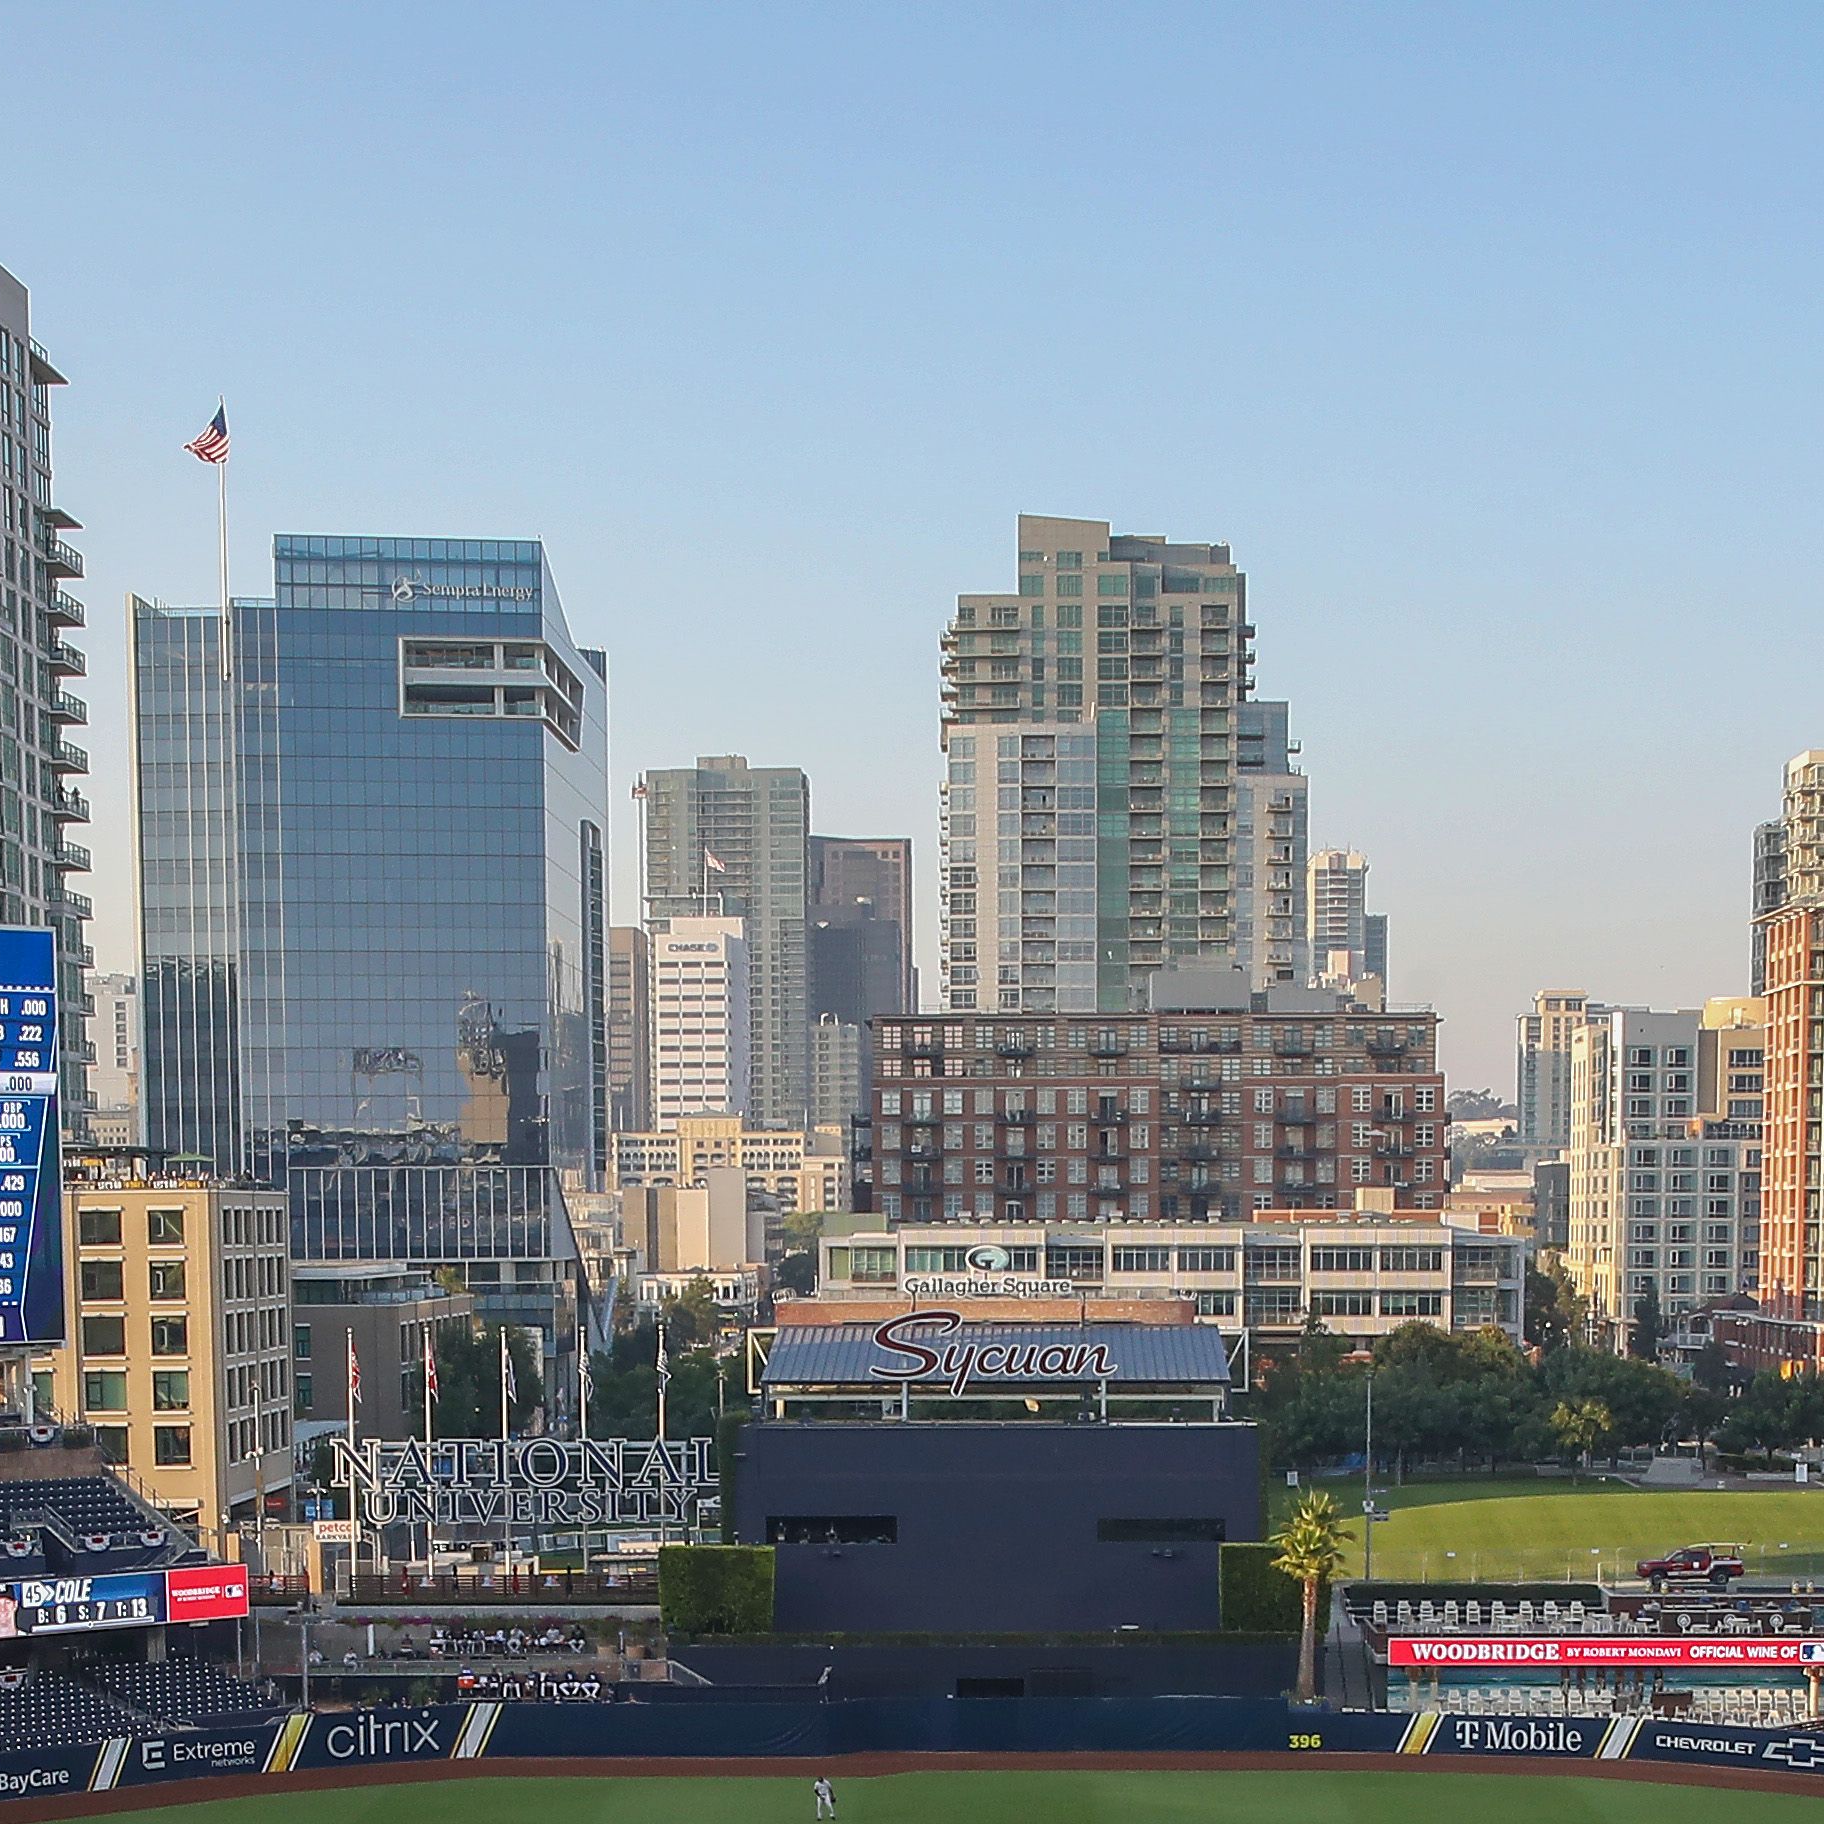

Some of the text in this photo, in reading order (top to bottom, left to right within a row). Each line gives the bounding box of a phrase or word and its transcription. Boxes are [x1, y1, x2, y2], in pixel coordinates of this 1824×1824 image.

[422, 582, 533, 601] Sempra Energy
[667, 943, 706, 952] CHASE
[904, 1276, 1073, 1298] Gallagher Square
[869, 1308, 1118, 1398] Sycuan
[329, 1435, 720, 1489] NATIONAL
[362, 1487, 699, 1526] UNIVERSITY
[55, 1579, 93, 1604] COLE
[1412, 1642, 1798, 1661] WOODBRIDGE BY ROBERT MONDAVI OFFICIAL WINE OF
[325, 1709, 441, 1759] citrix
[1288, 1733, 1322, 1751] 396
[1485, 1720, 1583, 1752] Mobile
[1655, 1735, 1757, 1756] CHEVROLET
[172, 1738, 256, 1764] Extreme
[211, 1755, 256, 1769] networks
